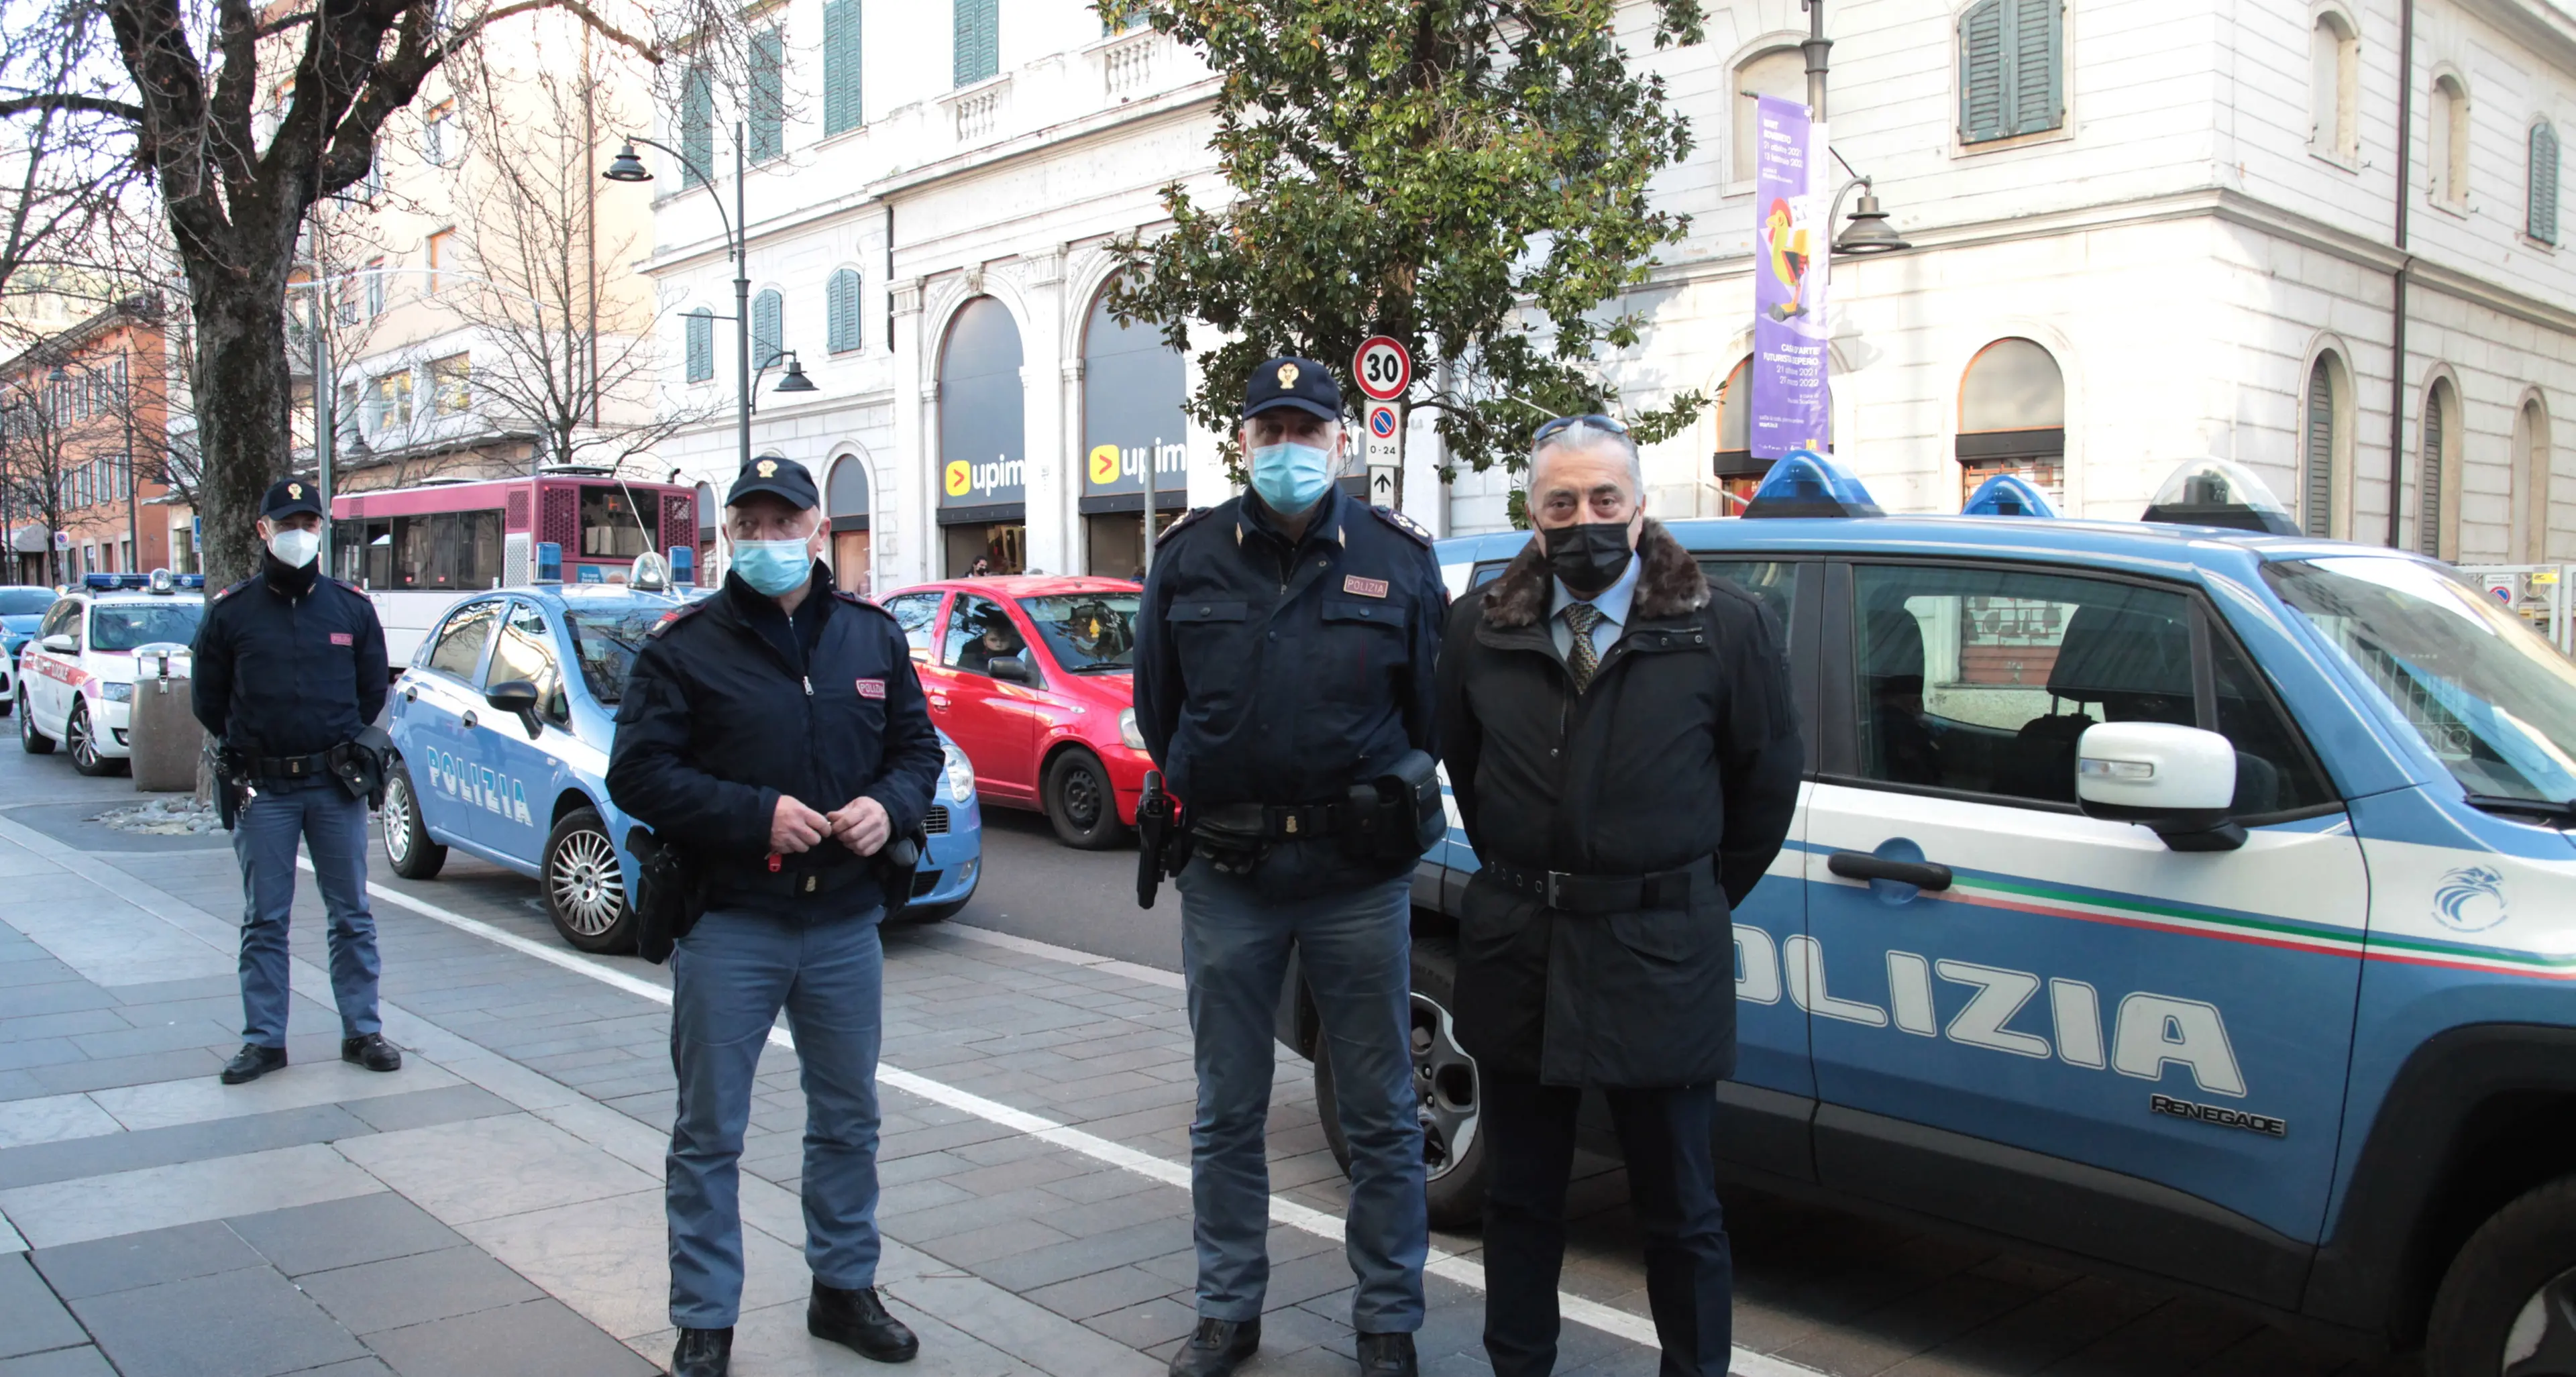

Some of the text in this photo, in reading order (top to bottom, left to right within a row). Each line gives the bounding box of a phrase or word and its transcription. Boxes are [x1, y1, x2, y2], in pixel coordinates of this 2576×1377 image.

[1367, 353, 1398, 382] 30
[1776, 364, 1784, 373] 21
[1799, 368, 1818, 376] 2021
[1799, 378, 1819, 387] 2022
[973, 454, 1026, 497] upim
[1347, 579, 1383, 593] POLIZIA
[427, 745, 533, 827] POLIZIA
[1733, 924, 2247, 1098] OLIZIA
[2151, 1093, 2286, 1136] RENEGADE
